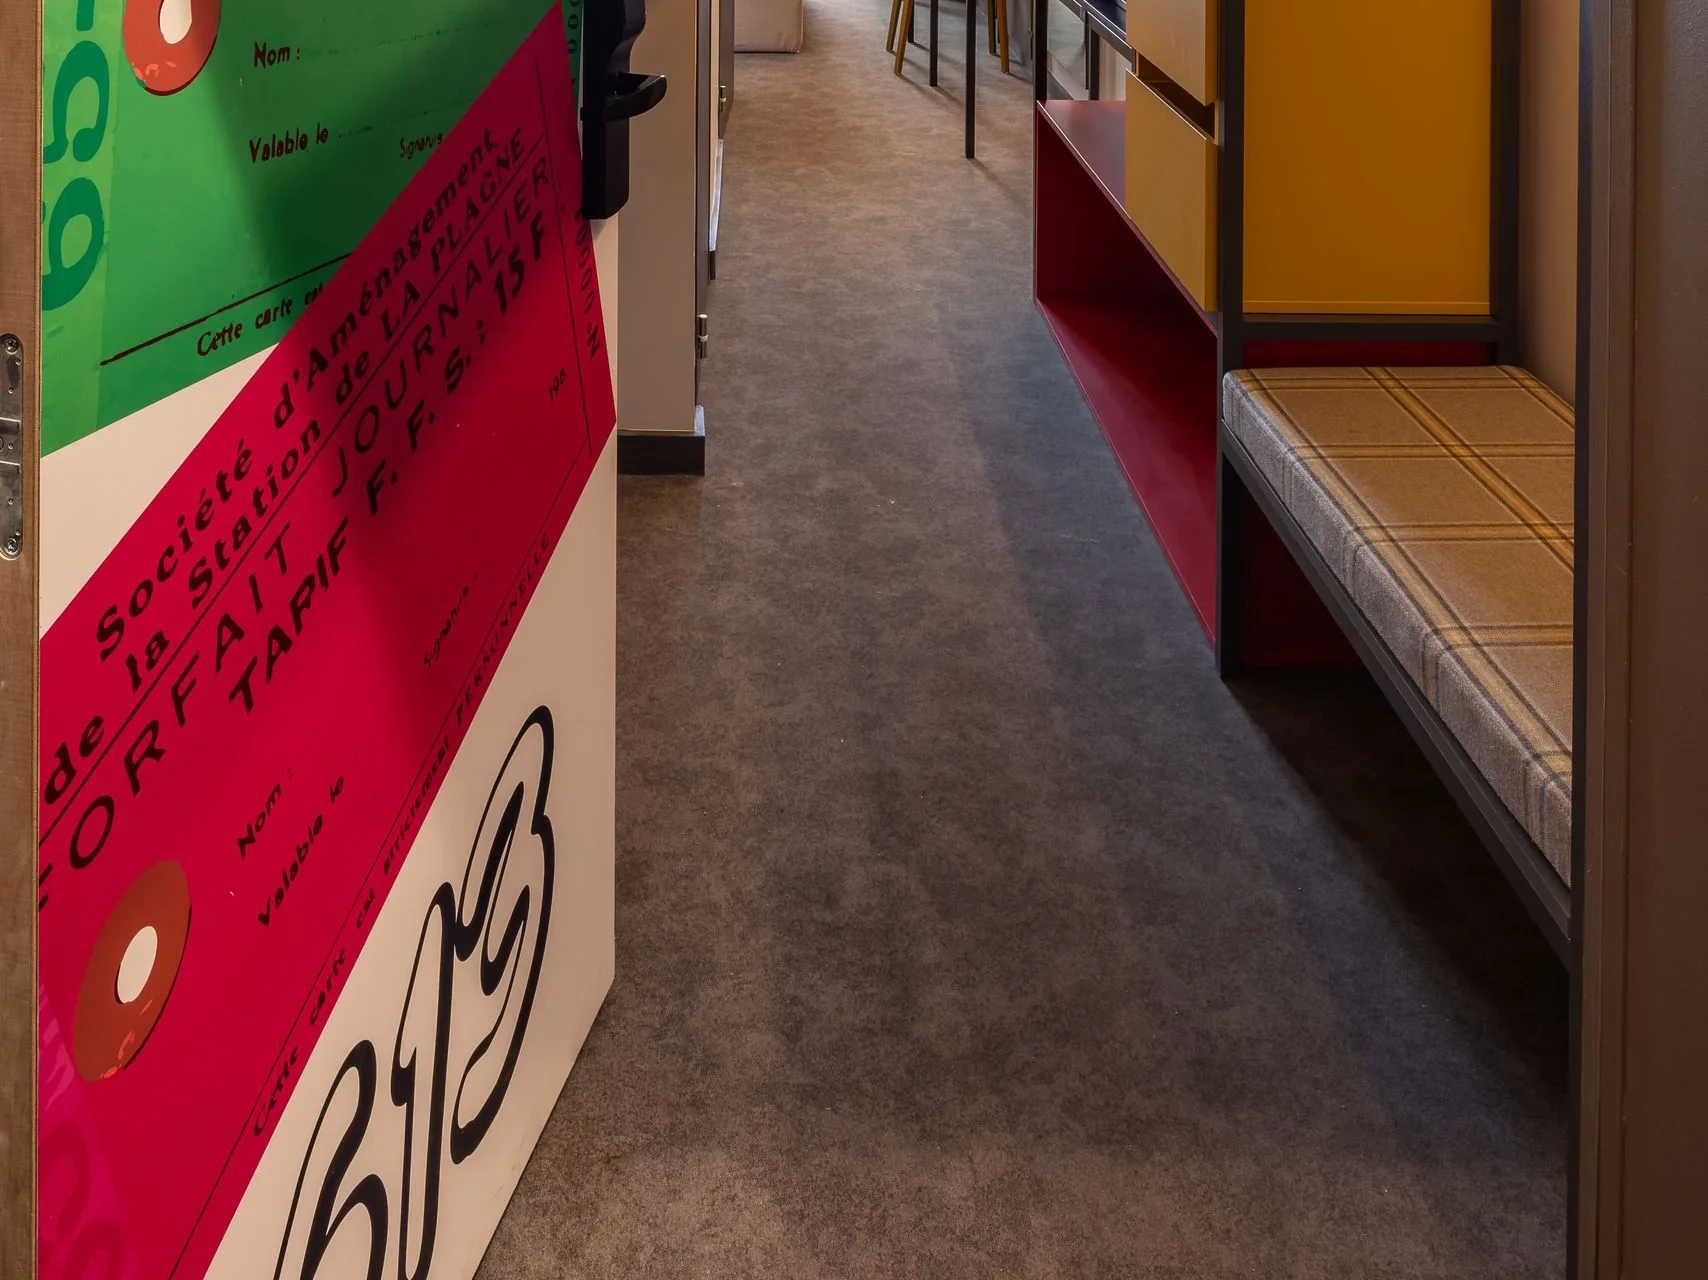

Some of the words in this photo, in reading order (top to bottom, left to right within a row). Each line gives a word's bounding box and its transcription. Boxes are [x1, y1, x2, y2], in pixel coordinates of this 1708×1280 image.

[253, 40, 292, 70] Nom
[248, 127, 309, 164] Valable
[316, 122, 330, 145] le
[197, 322, 243, 357] Cette
[255, 297, 294, 330] carte
[332, 155, 550, 498] JOURNALIER
[95, 438, 253, 663] Société
[274, 127, 500, 430] d'Aménagement
[44, 715, 104, 806] de
[125, 631, 170, 694] la
[188, 417, 322, 610] Station
[335, 350, 371, 406] de
[380, 279, 422, 343] LA
[430, 126, 525, 276] PLAGNE
[230, 514, 350, 716] TARIF
[492, 243, 526, 317] 15
[530, 210, 547, 262] F
[237, 783, 283, 861] Nom
[258, 812, 325, 928] Valable
[329, 774, 346, 806] le
[253, 1045, 300, 1138] Cette
